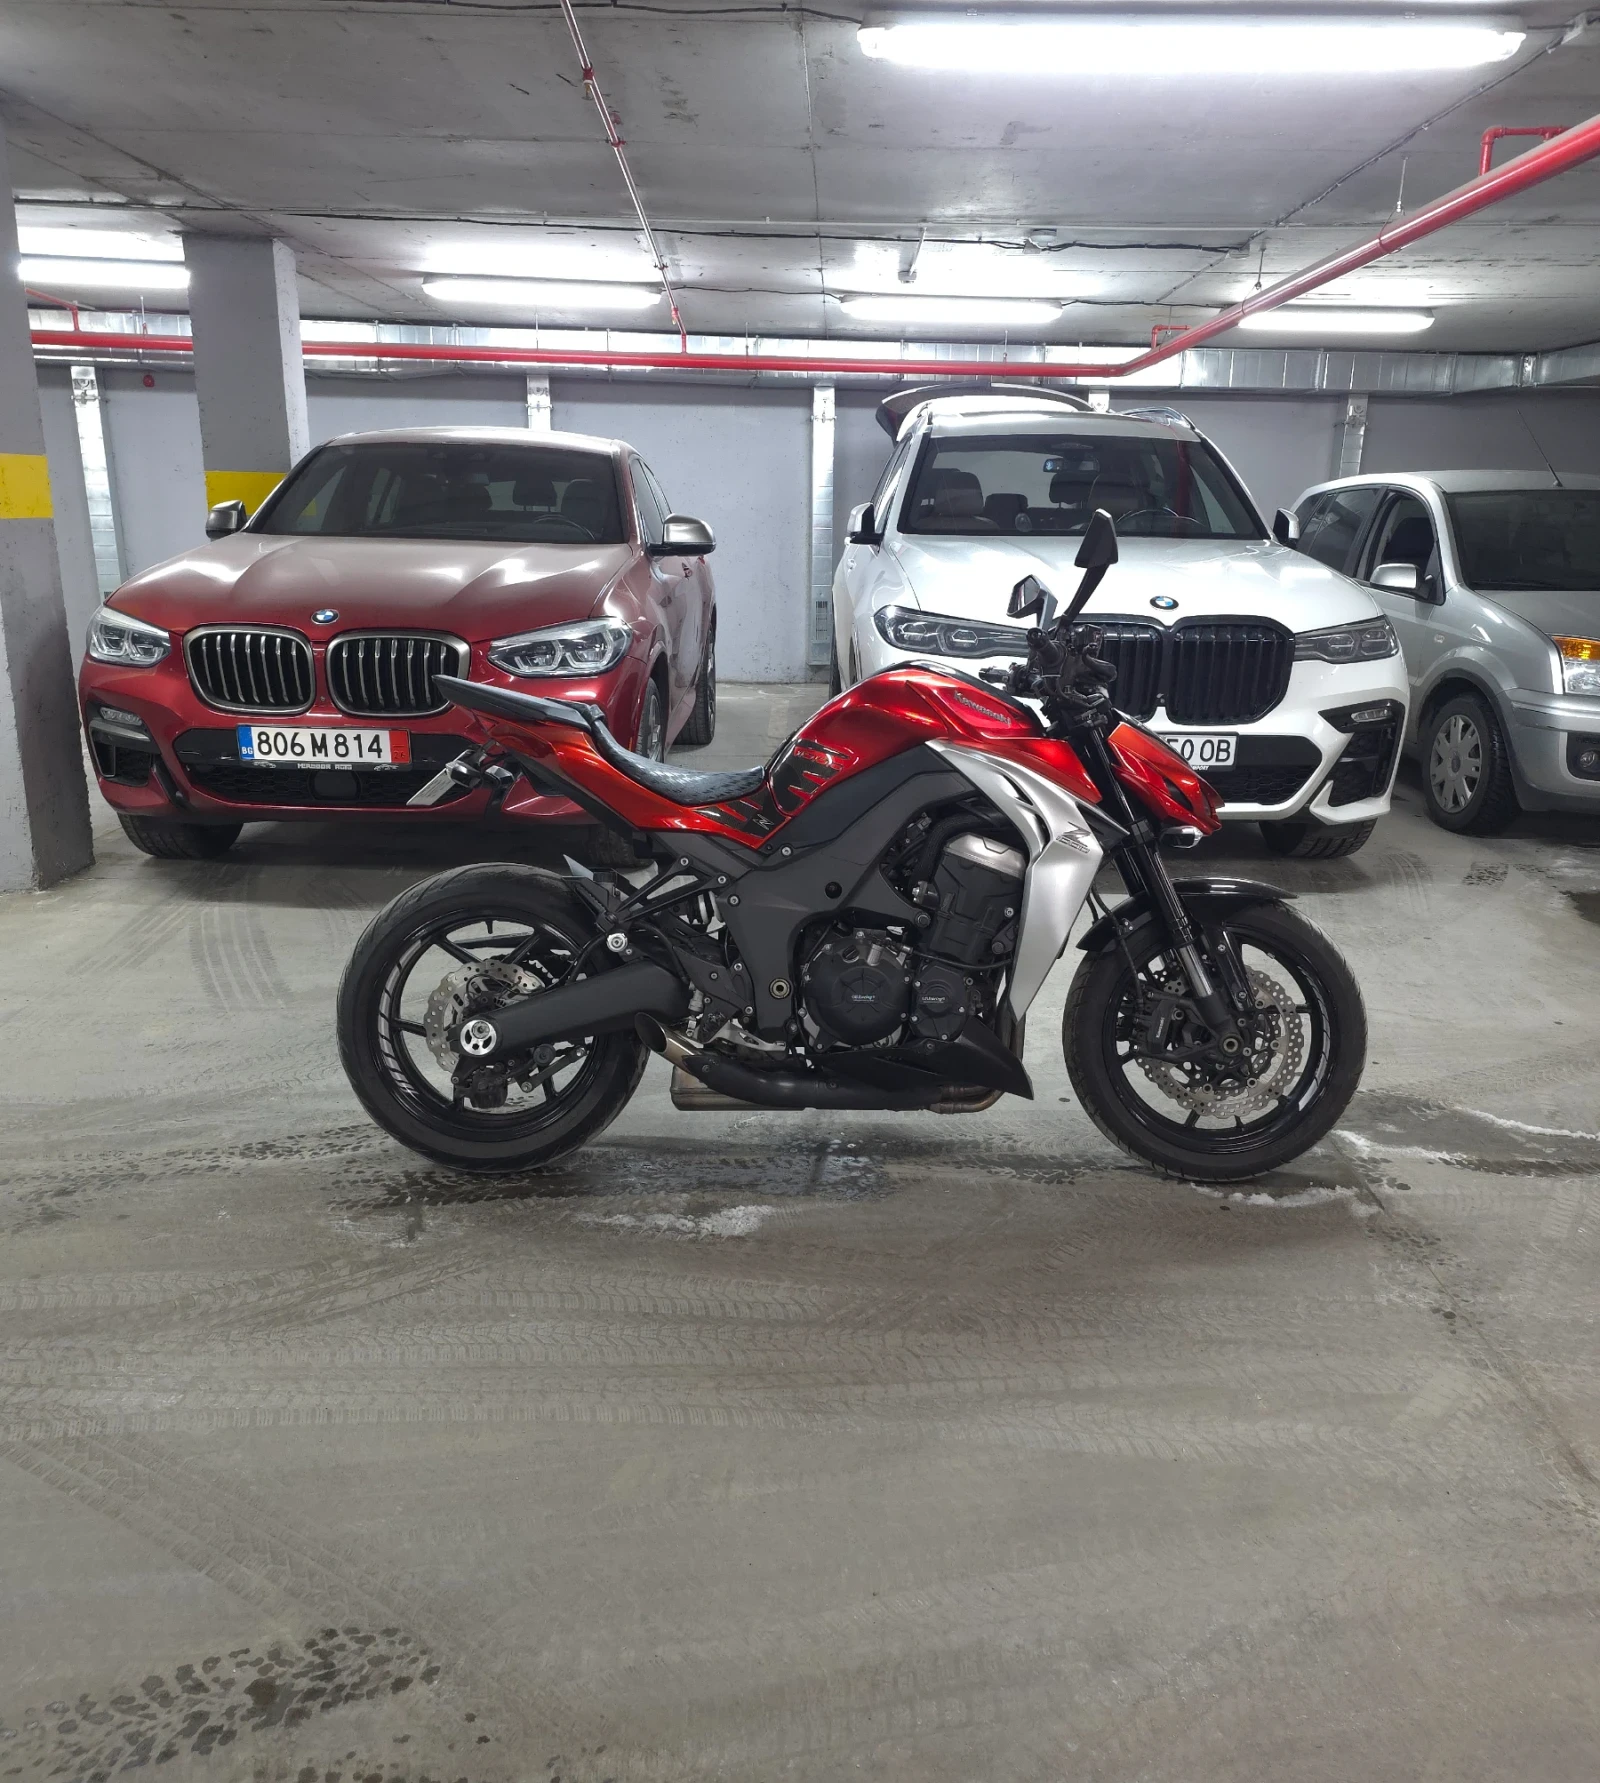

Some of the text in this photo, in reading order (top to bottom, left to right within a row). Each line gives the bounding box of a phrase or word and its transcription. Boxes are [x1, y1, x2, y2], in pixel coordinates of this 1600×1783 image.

[954, 690, 1011, 728] Kawasaki
[241, 747, 254, 755] BG
[257, 731, 383, 759] 806 M 814
[1167, 738, 1195, 761] 0
